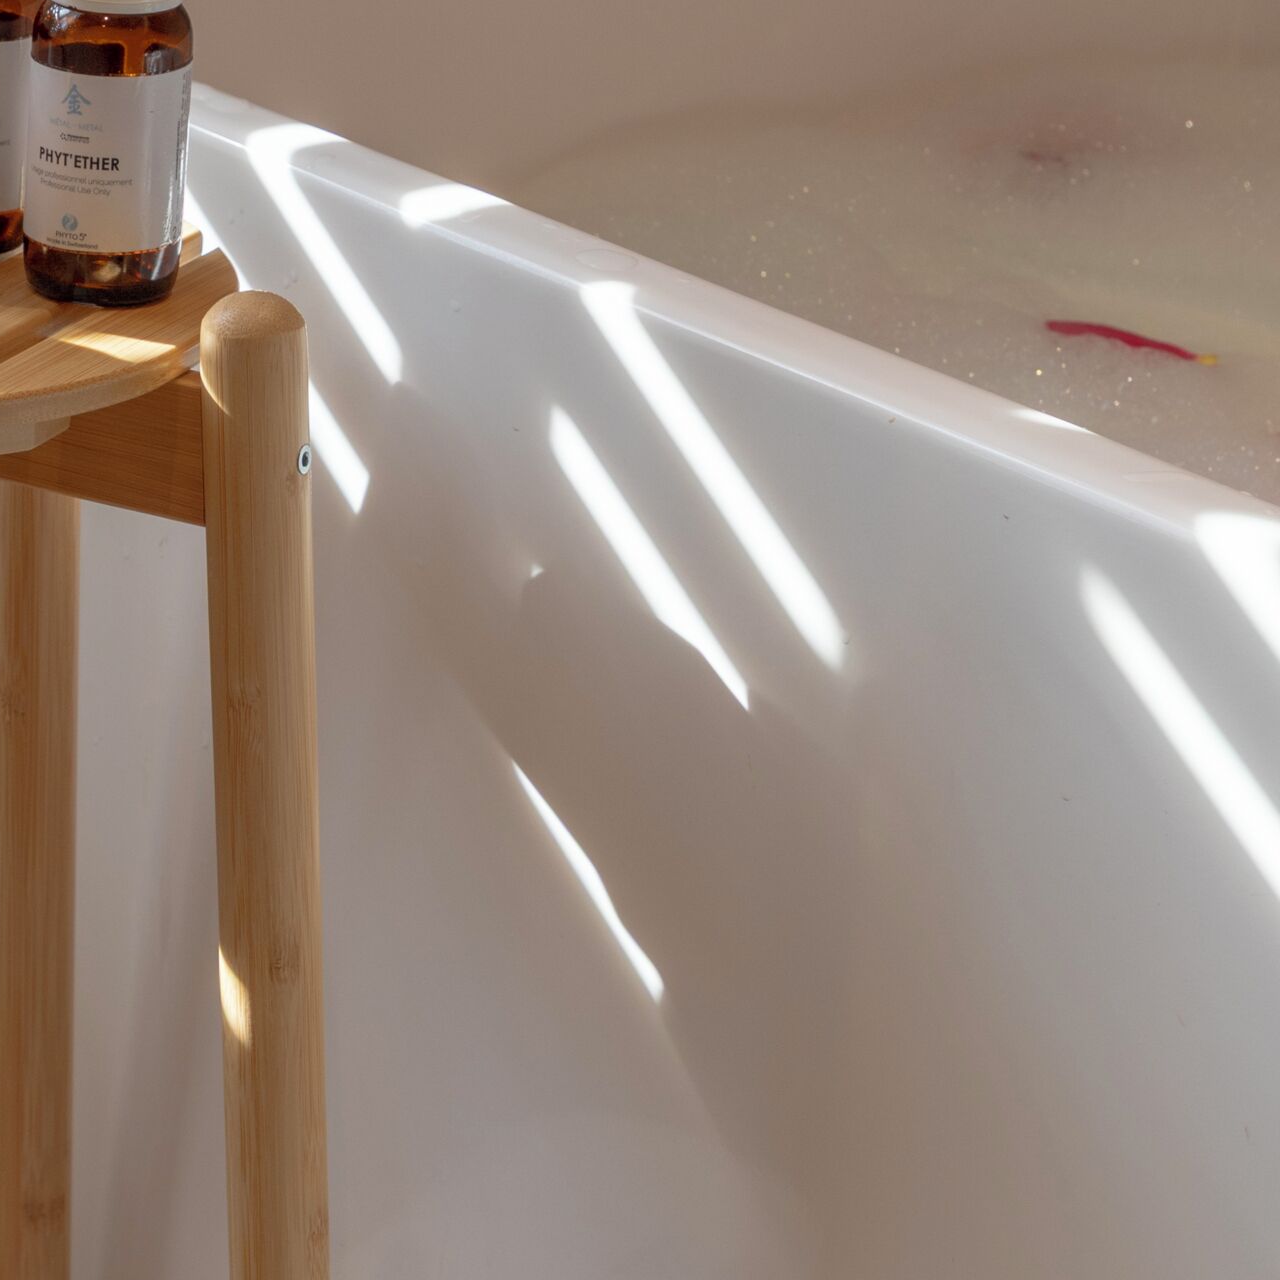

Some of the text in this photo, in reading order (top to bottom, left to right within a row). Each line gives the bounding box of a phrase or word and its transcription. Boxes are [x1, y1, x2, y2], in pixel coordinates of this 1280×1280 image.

[62, 84, 92, 116] 金
[39, 146, 120, 171] PHYT'ETHER
[88, 177, 132, 186] uniquement
[77, 185, 91, 195] Use
[93, 187, 111, 196] Only
[55, 230, 78, 241] PHYTO
